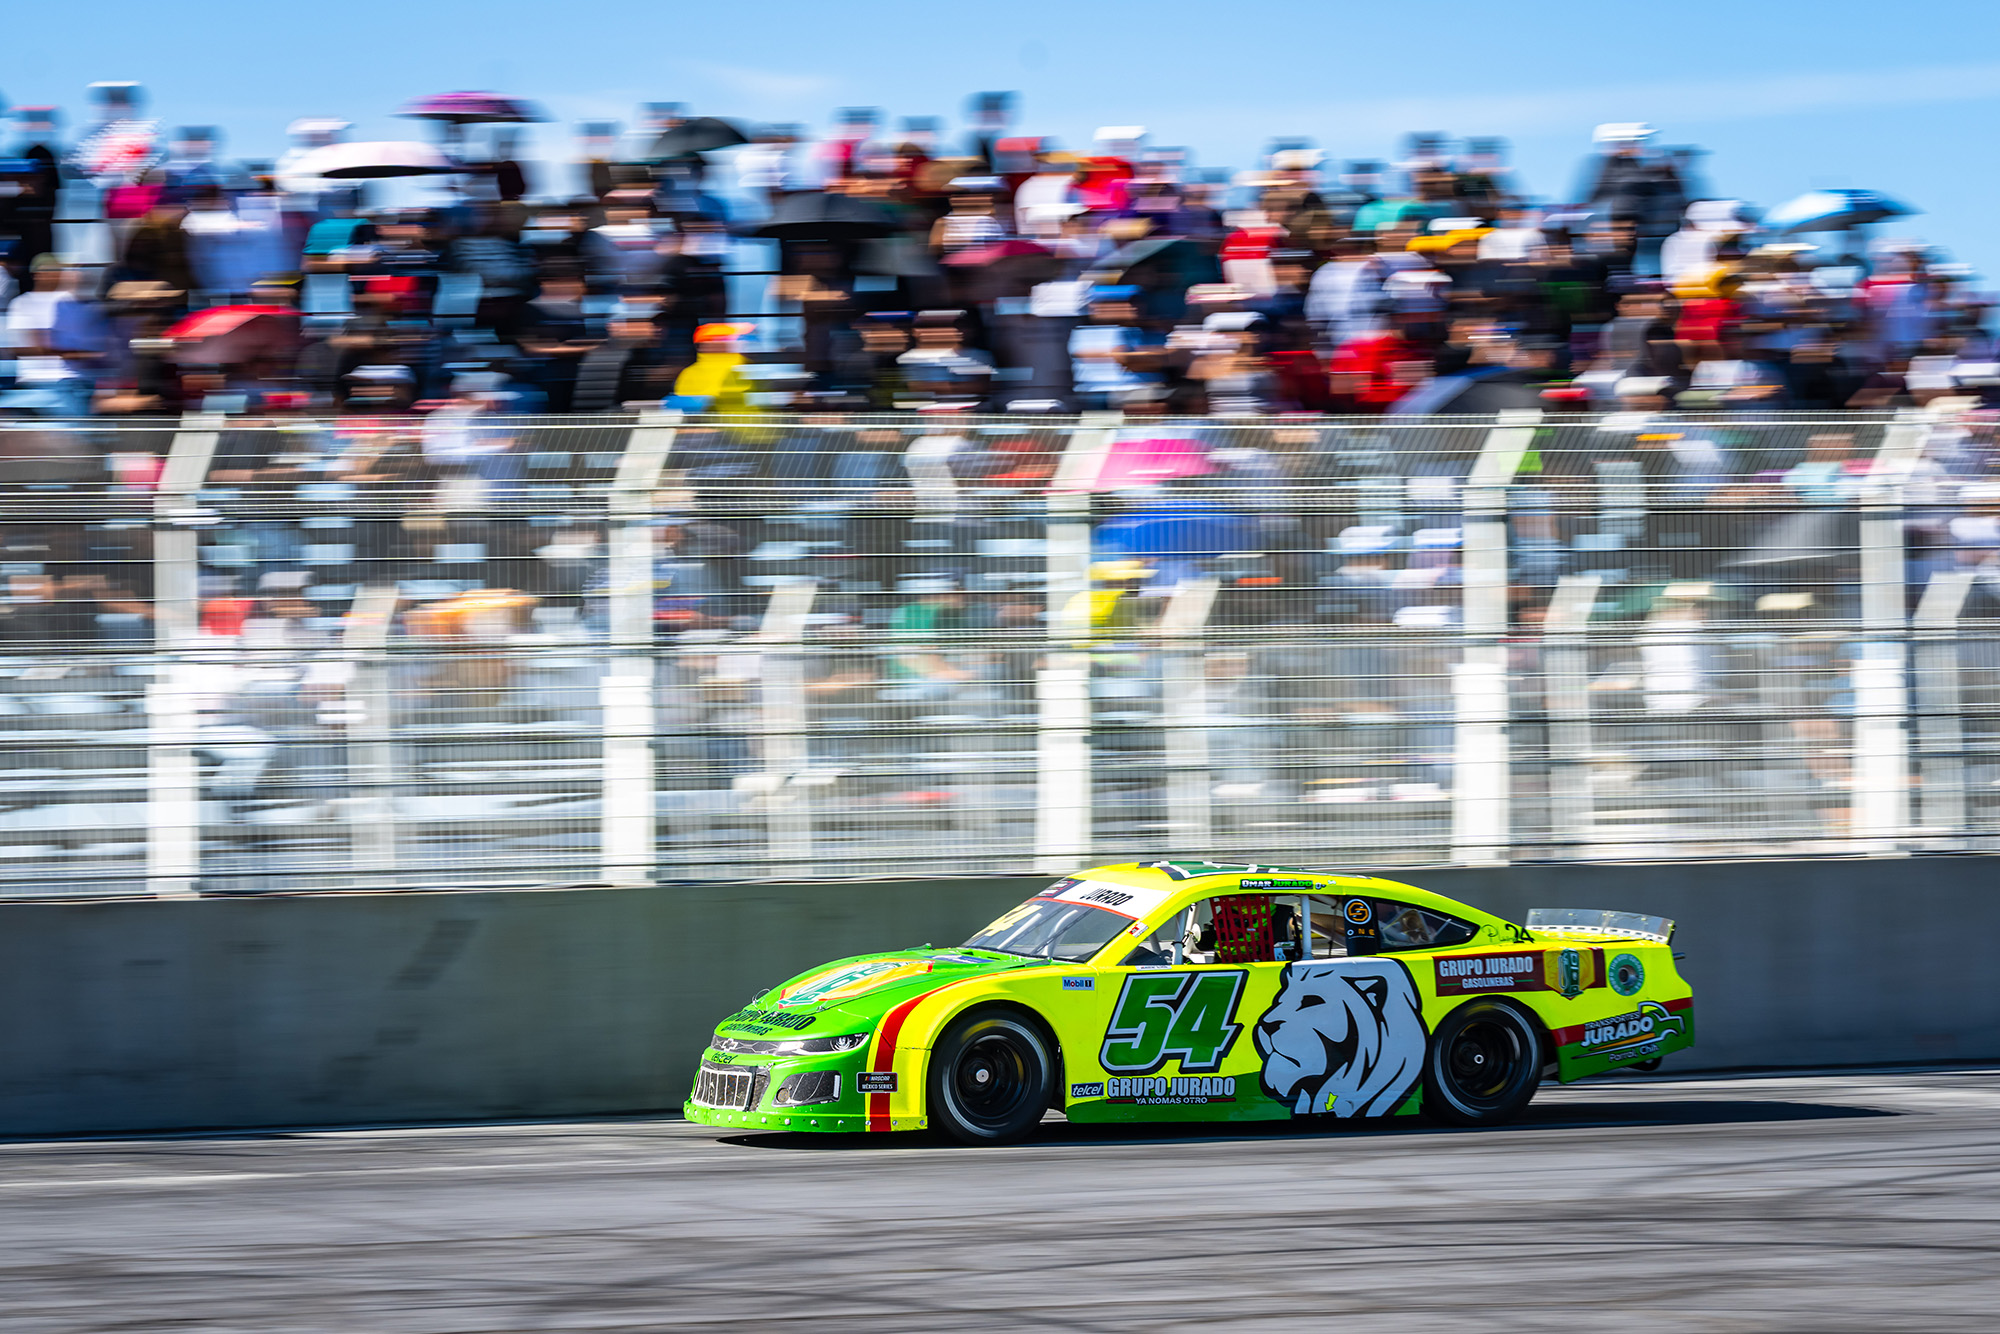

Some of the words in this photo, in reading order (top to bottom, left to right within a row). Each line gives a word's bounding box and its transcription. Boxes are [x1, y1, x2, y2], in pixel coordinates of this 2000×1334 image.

[1505, 924, 1535, 944] 24
[1439, 959, 1483, 977] GRUPO
[1485, 956, 1534, 974] JURADO
[1063, 979, 1084, 988] Mobil
[1462, 976, 1515, 989] GASOLINERAS
[1098, 970, 1249, 1076] 54
[1585, 1011, 1640, 1030] TRANSPORTES
[1580, 1016, 1654, 1047] JURADO
[1073, 1084, 1102, 1096] telcel
[1108, 1078, 1167, 1097] GRUPO
[1170, 1078, 1236, 1097] JURADO
